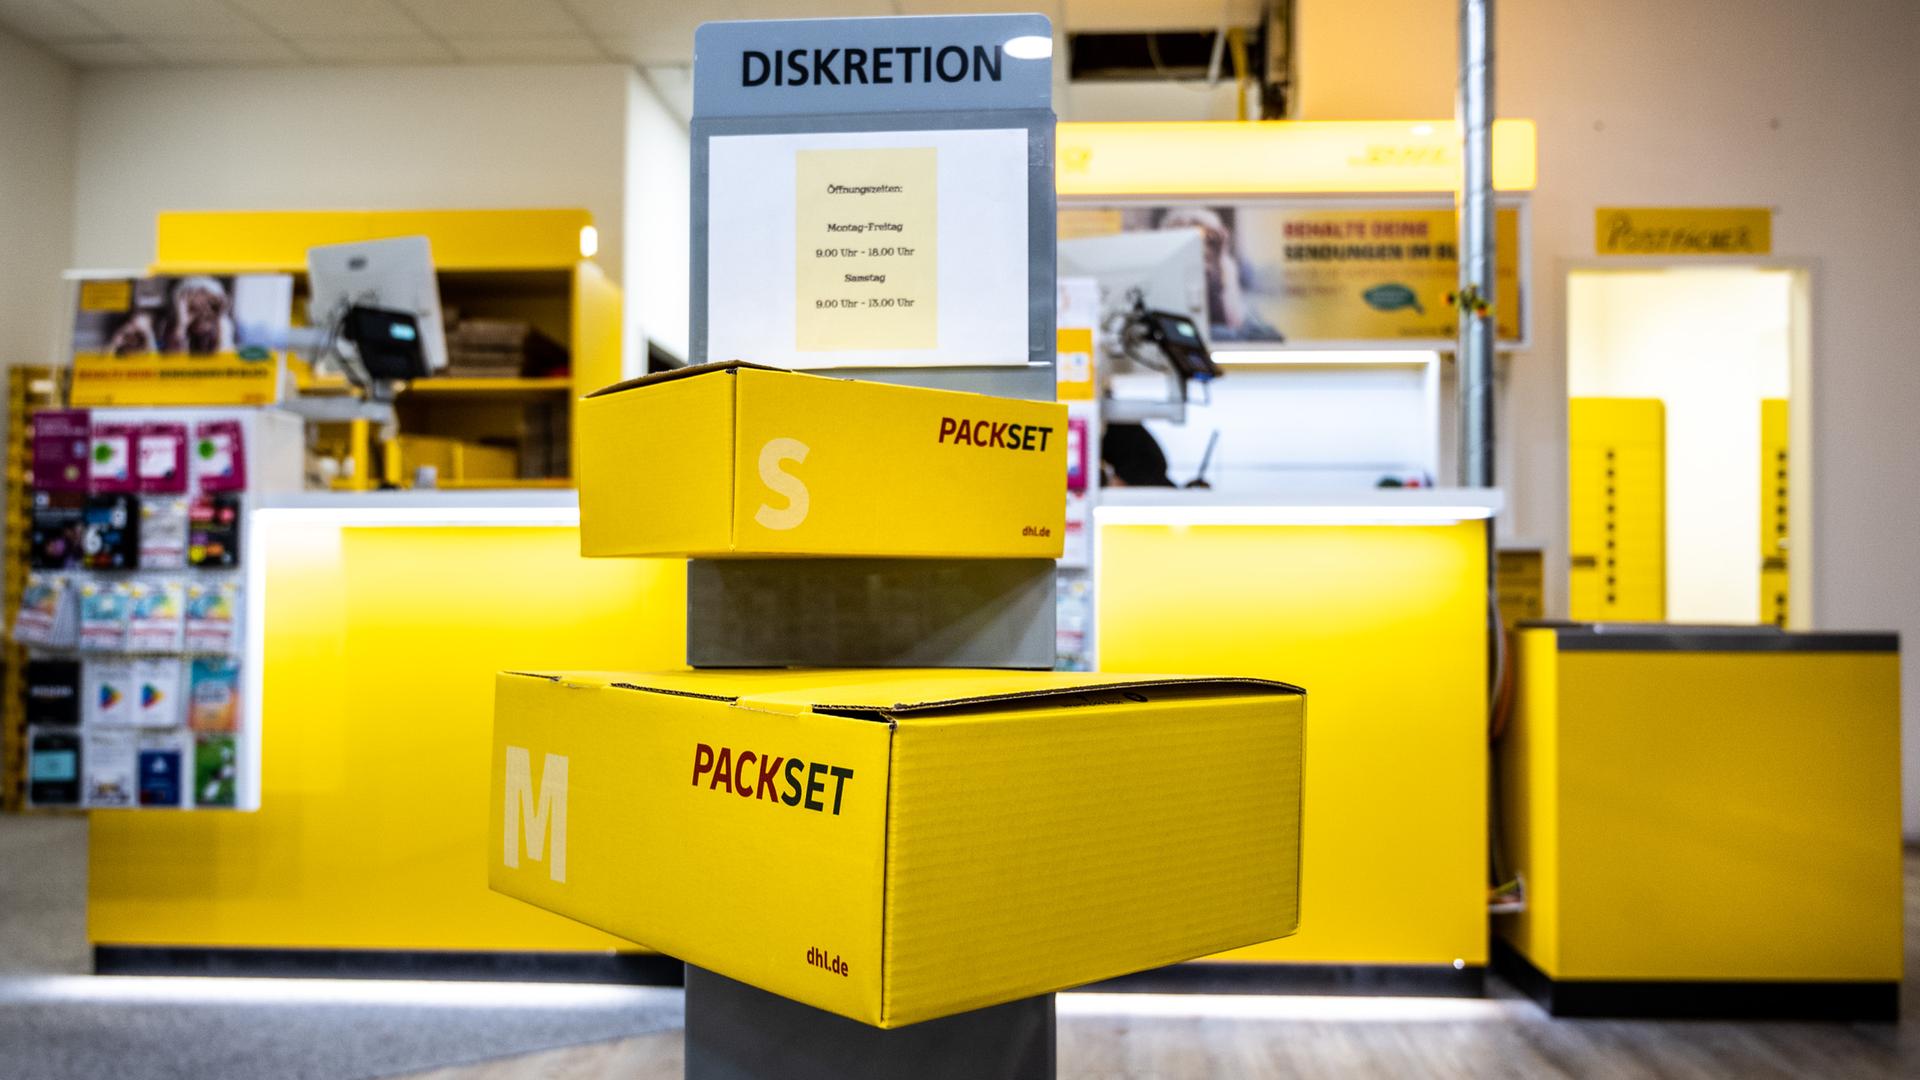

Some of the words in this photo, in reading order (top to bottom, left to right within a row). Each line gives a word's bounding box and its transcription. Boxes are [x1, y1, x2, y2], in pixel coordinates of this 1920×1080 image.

[741, 45, 1003, 88] DISKRETION
[827, 184, 903, 195] Öffnungszeiten:
[827, 222, 903, 233] Montag-Freitag
[815, 248, 838, 258] 9.00
[840, 248, 858, 257] Uhr
[868, 247, 894, 257] 18.00
[897, 247, 915, 256] Uhr
[844, 274, 886, 284] Samstag
[815, 299, 838, 308] 9.00
[840, 299, 858, 308] Uhr
[897, 298, 915, 307] Uhr
[938, 416, 1054, 453] PACKSET
[755, 437, 810, 531] S
[1022, 525, 1051, 538] dhl.de
[691, 743, 854, 816] PACKSET
[504, 746, 568, 883] M
[805, 945, 849, 978] dhl.de
